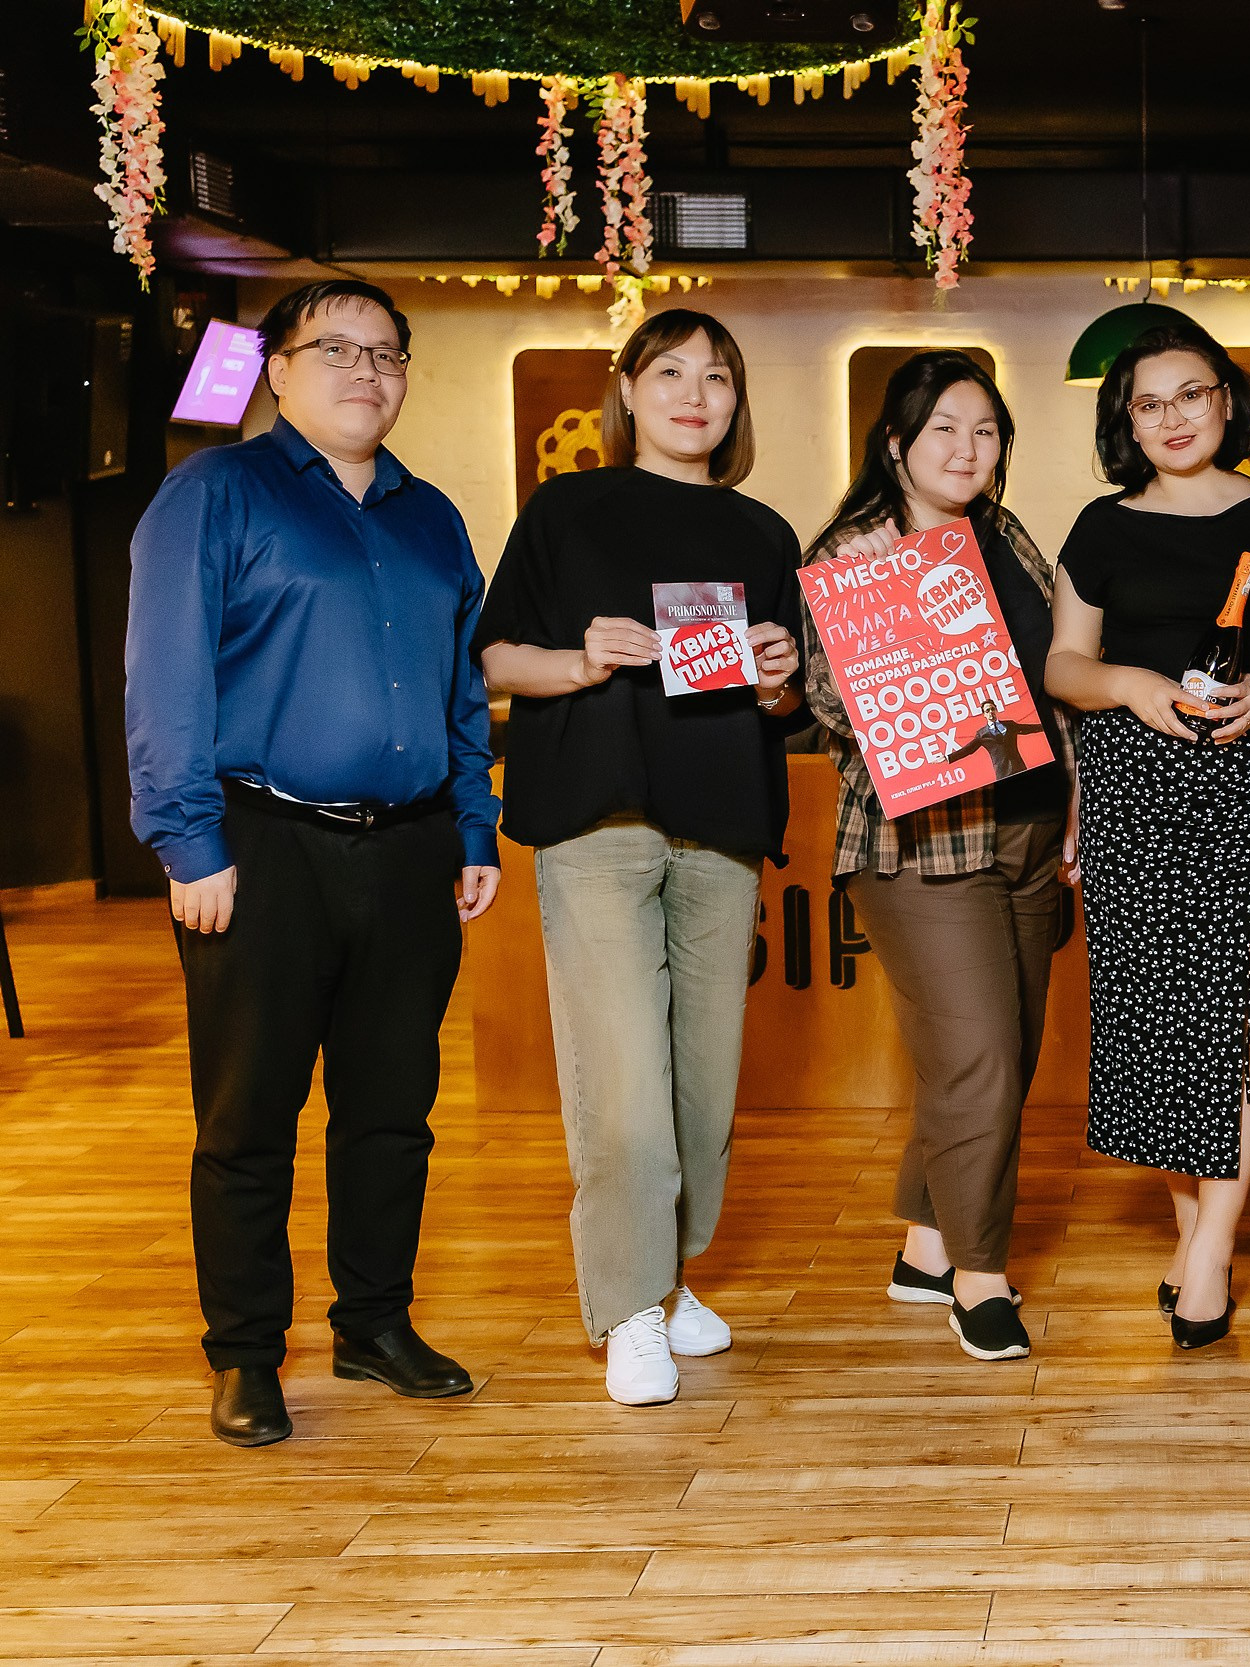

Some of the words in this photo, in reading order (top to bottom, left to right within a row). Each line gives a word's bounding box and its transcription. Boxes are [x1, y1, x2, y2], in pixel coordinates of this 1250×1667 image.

[815, 577, 830, 598] 1
[832, 549, 922, 594] МЕСТО
[668, 604, 737, 617] PRIKOSNOVENIE
[826, 604, 912, 645] ПАЛАТА
[844, 647, 914, 678] КОМАНДЕ,
[849, 663, 912, 693] КОТОРАЯ
[912, 641, 981, 673] РАЗНЕСЛА
[876, 727, 963, 779] ВСЕХ
[937, 767, 966, 787] 110
